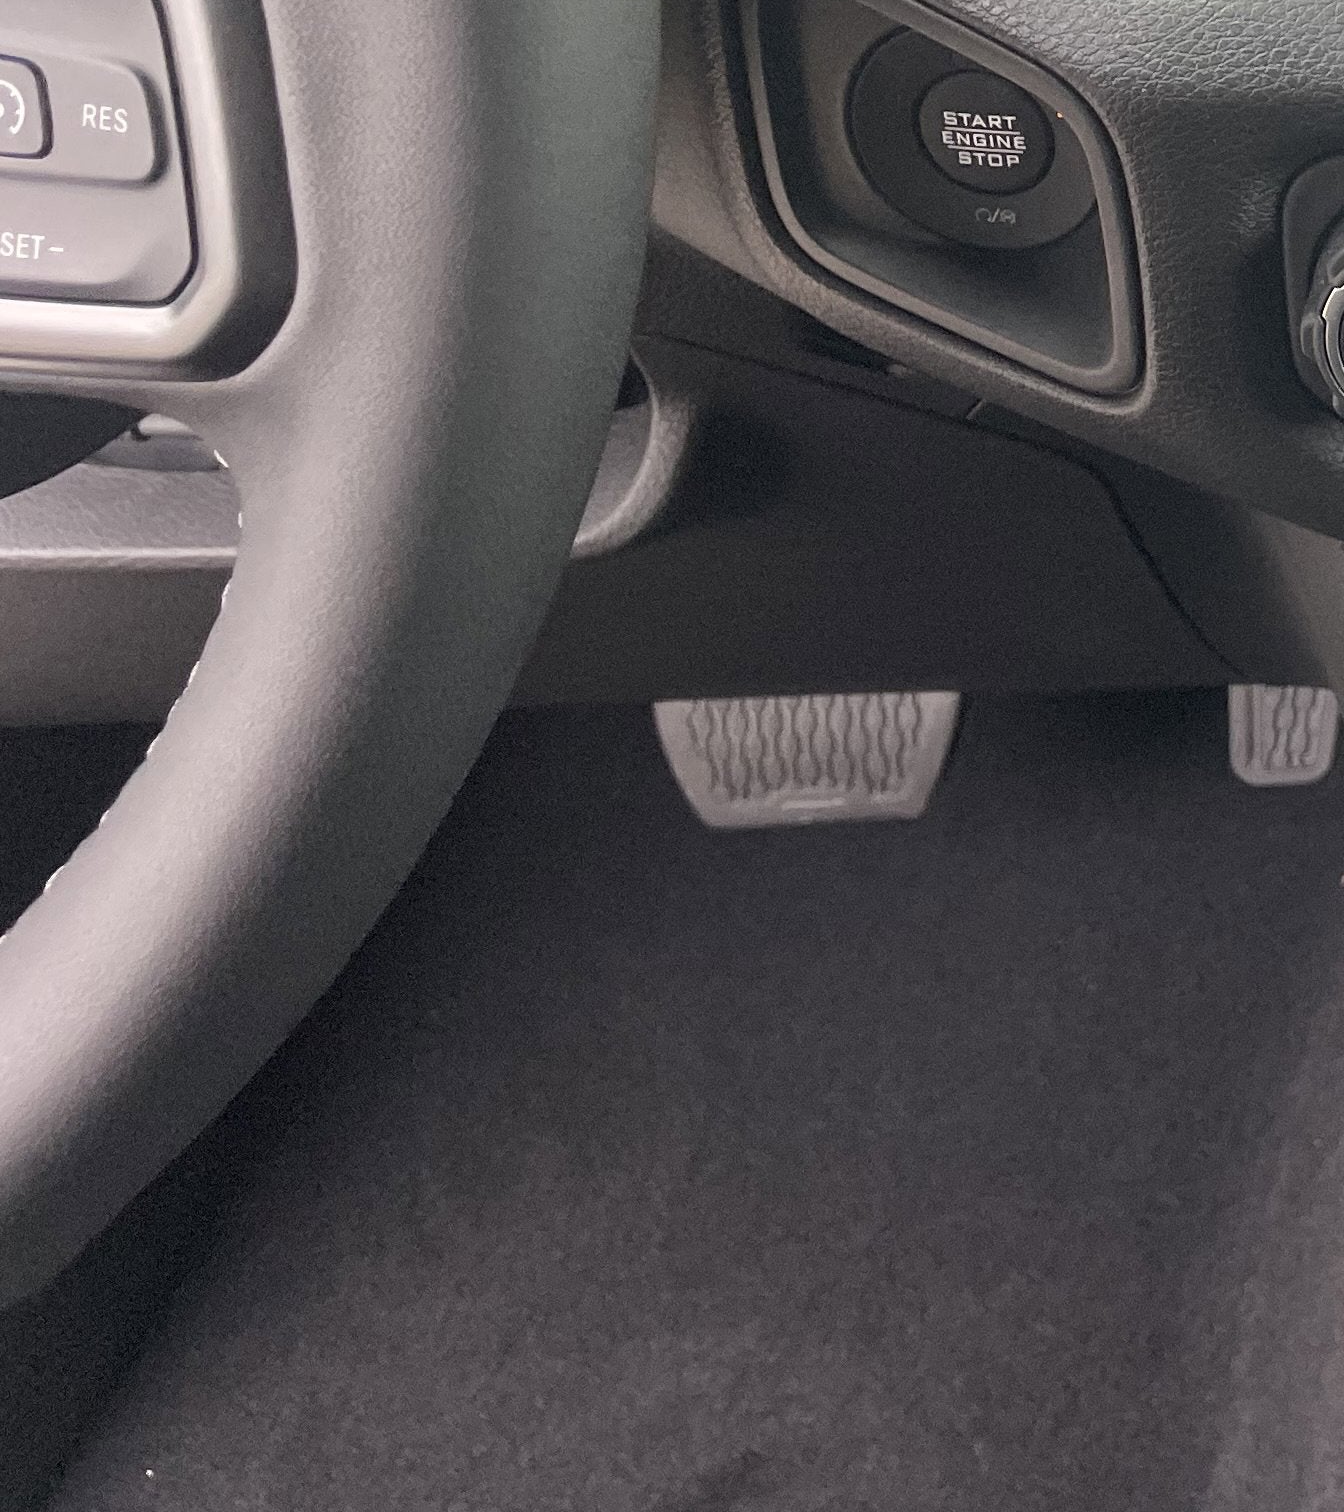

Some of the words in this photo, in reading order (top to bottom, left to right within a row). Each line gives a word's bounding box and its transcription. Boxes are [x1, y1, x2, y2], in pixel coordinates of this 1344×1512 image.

[82, 103, 128, 133] RES
[943, 110, 1016, 130] START
[941, 131, 1026, 150] ENGINE
[958, 151, 1020, 168] STOP
